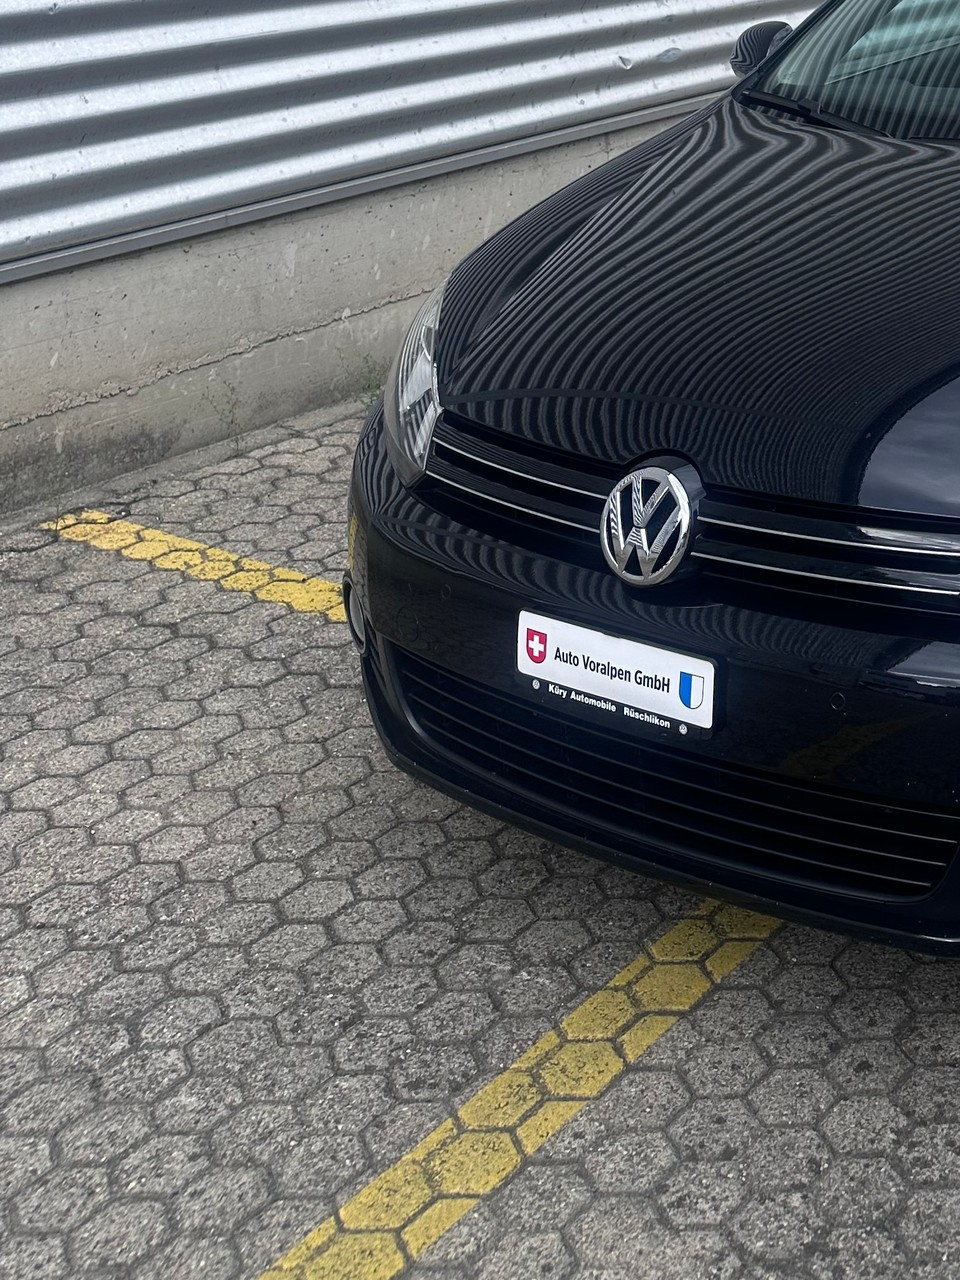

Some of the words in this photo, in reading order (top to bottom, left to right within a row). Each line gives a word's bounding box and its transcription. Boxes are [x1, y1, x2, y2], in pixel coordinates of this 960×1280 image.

[554, 647, 580, 667] Auto
[582, 654, 631, 682] Voralpen
[634, 670, 671, 693] GmbH
[548, 683, 568, 699] Küry
[570, 691, 617, 712] Automobile
[623, 706, 671, 729] Rüschlikon
